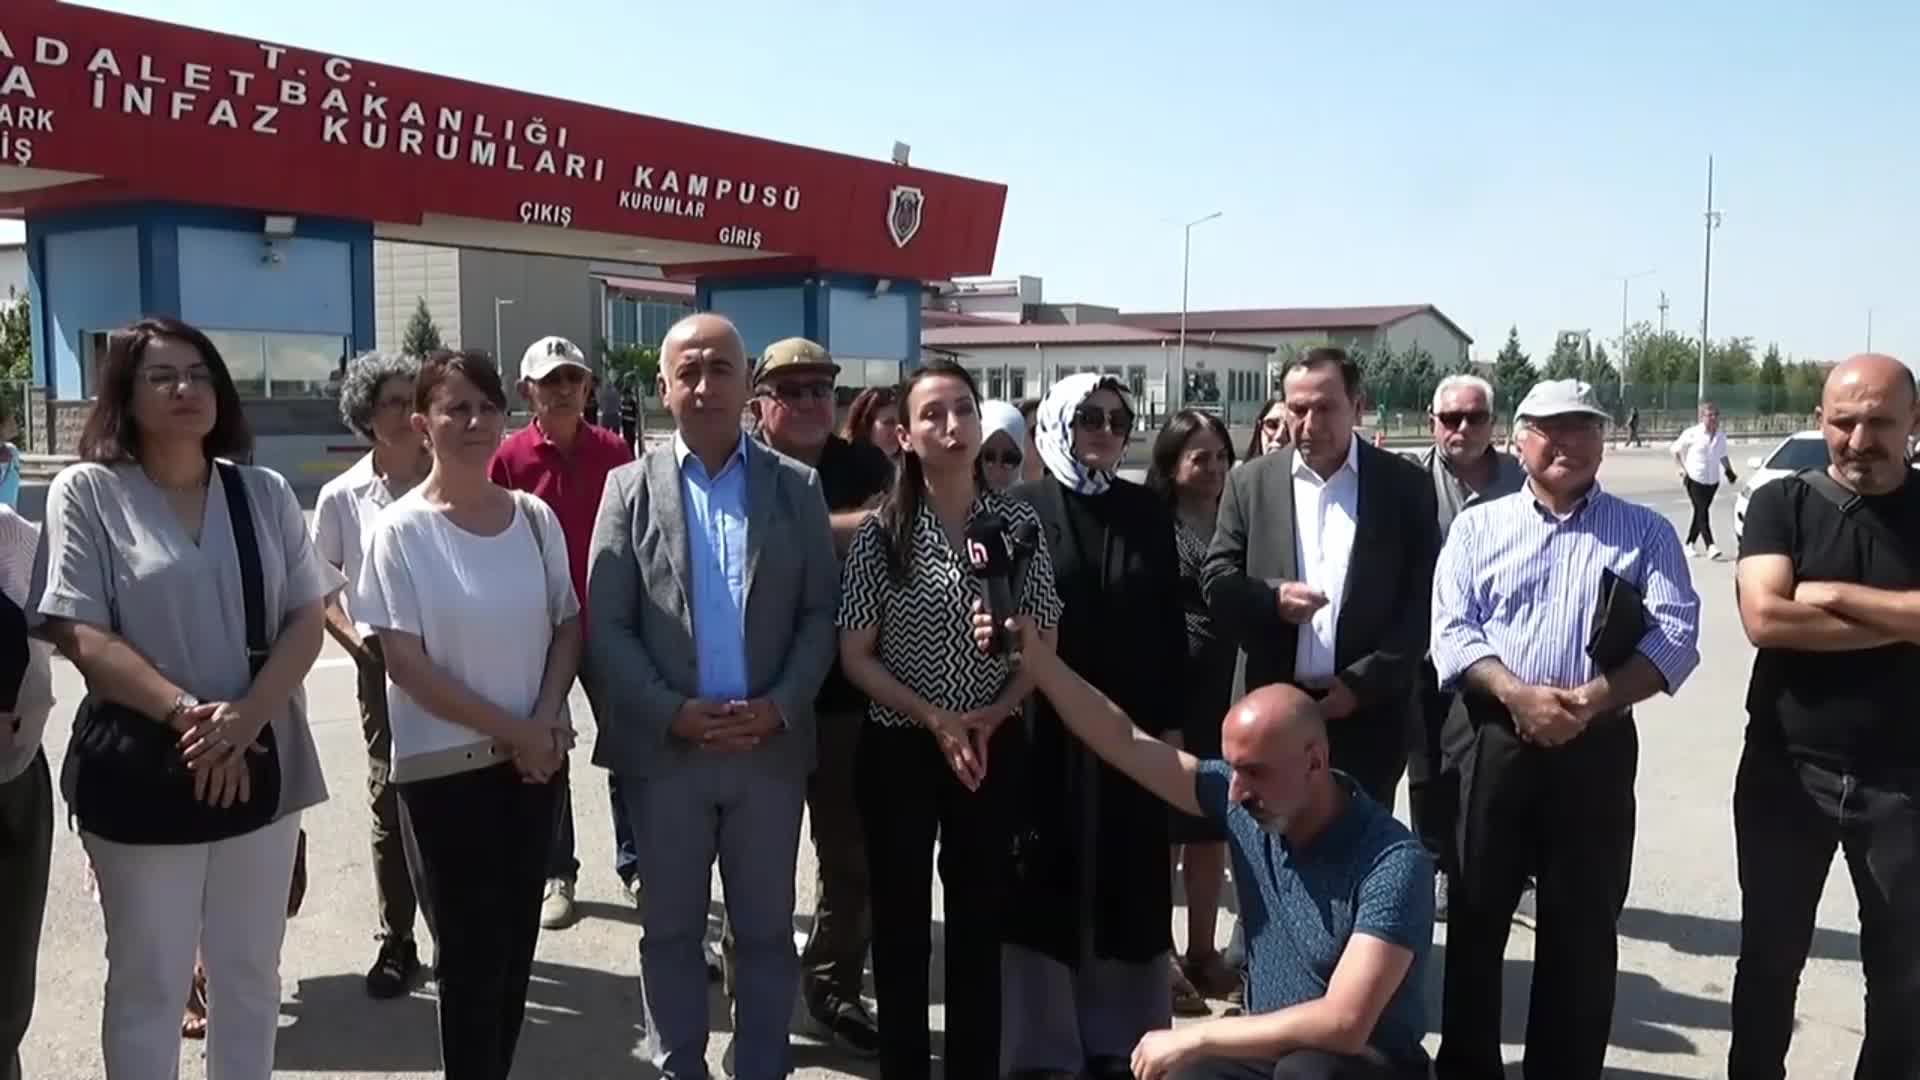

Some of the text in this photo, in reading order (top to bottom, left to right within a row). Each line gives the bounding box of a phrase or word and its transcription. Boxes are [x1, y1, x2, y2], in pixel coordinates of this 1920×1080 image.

[280, 78, 568, 149] BAKANLIĞI
[93, 72, 279, 135] İNFAZ
[323, 115, 604, 181] KURUMLARI
[634, 165, 800, 211] KAMPUSÜ
[519, 201, 573, 228] ÇIKIŞ
[618, 190, 706, 219] KURUMLAR
[718, 225, 762, 249] GİRİŞ
